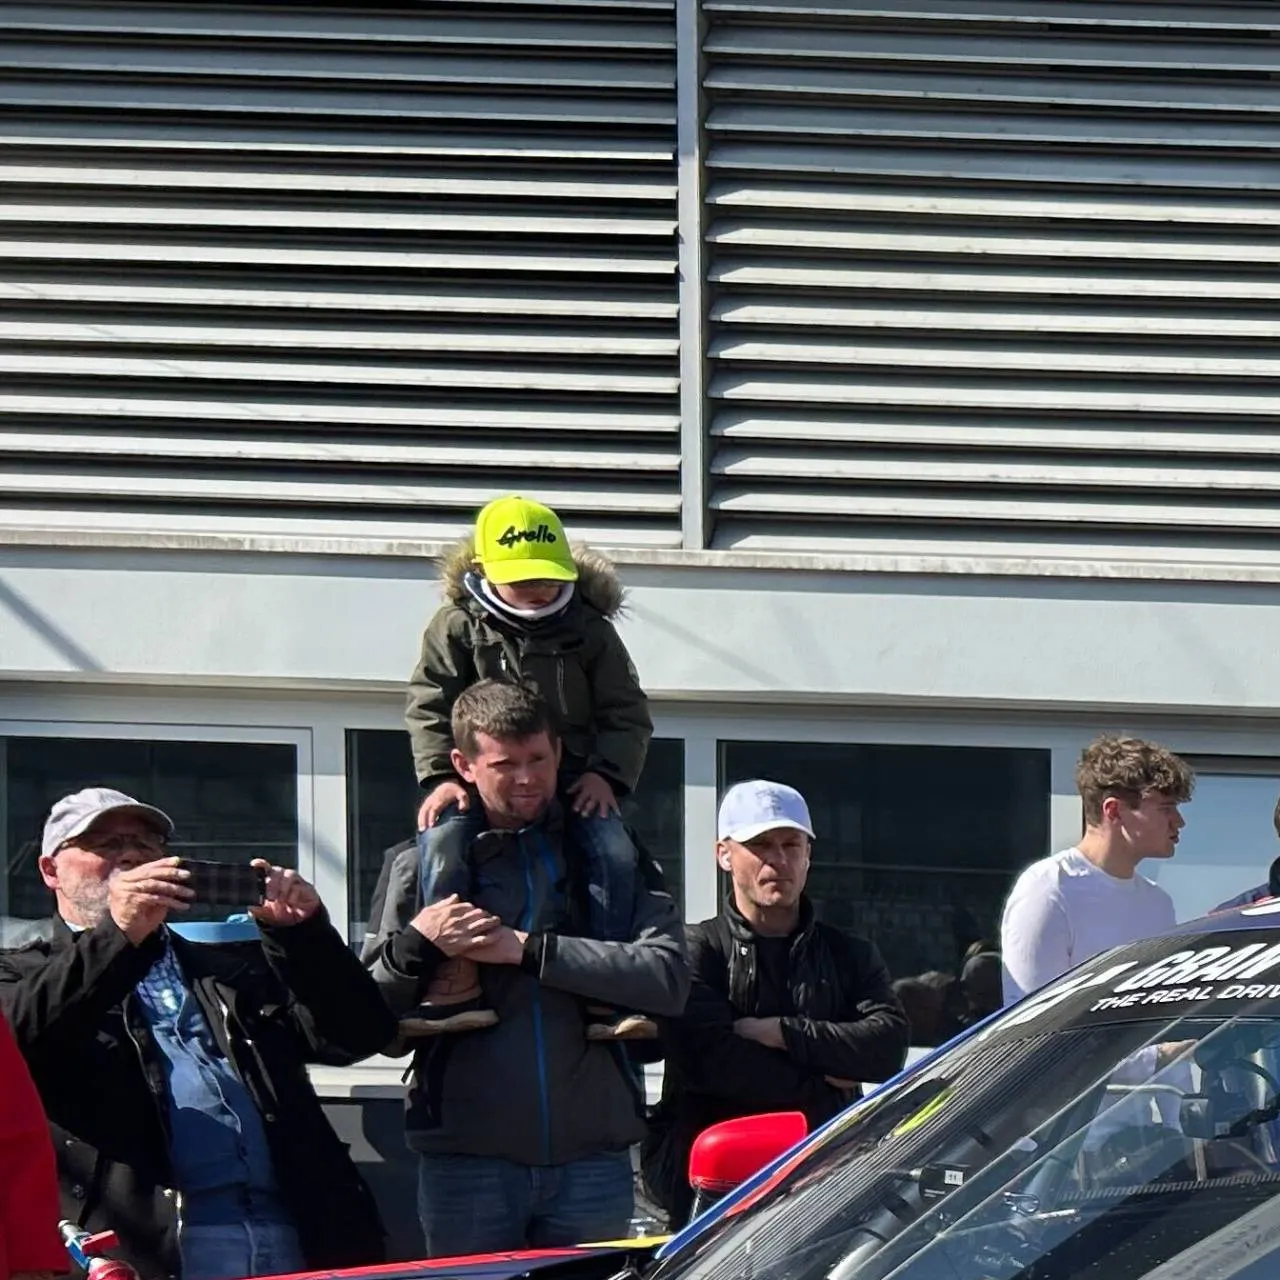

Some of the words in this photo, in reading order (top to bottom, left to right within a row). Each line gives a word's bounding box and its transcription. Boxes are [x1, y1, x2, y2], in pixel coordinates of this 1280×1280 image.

[496, 525, 556, 549] Grello
[1090, 997, 1146, 1013] THE
[1143, 985, 1215, 1004] REAL
